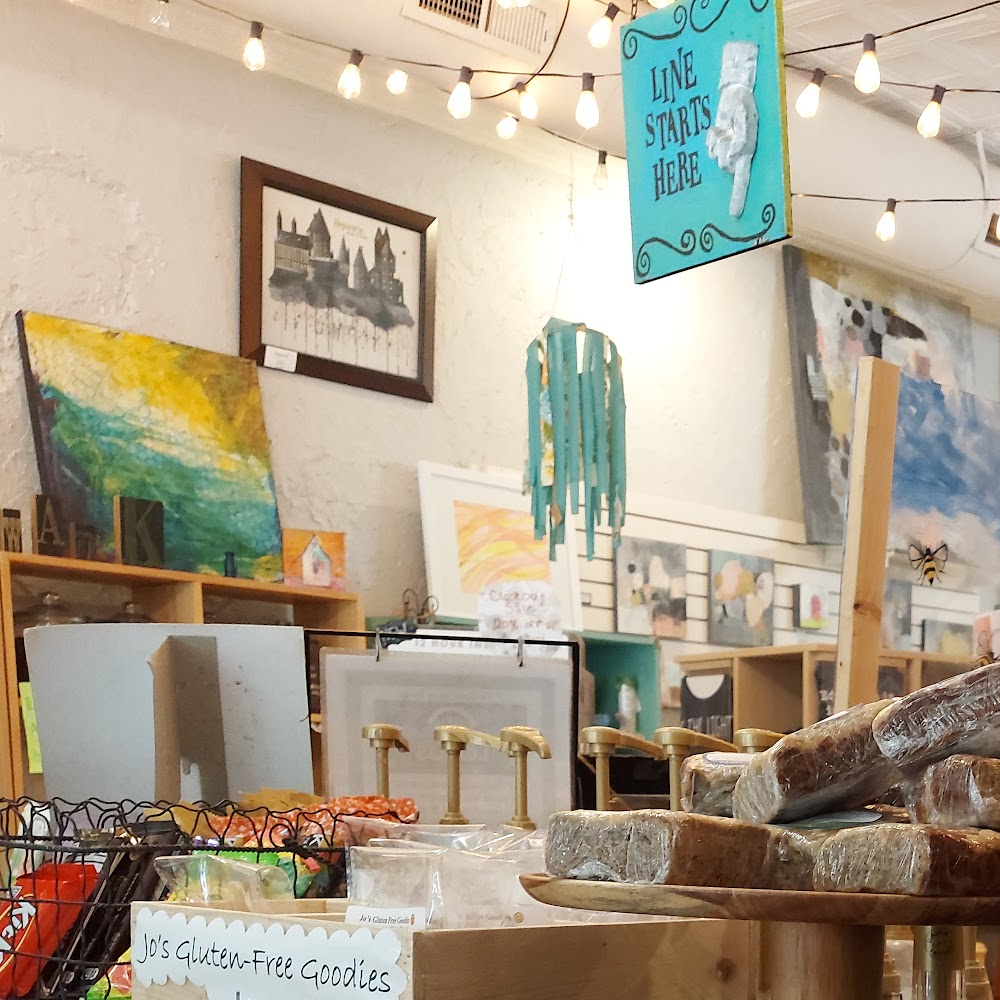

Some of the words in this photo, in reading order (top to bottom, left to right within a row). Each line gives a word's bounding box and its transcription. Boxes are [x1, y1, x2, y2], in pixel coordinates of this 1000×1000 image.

[650, 47, 697, 104] LINE
[645, 94, 711, 150] STARTS
[652, 151, 702, 201] HERE
[137, 933, 169, 964] Jo's
[176, 937, 293, 980] Gluten-Free
[301, 958, 391, 993] Goodies
